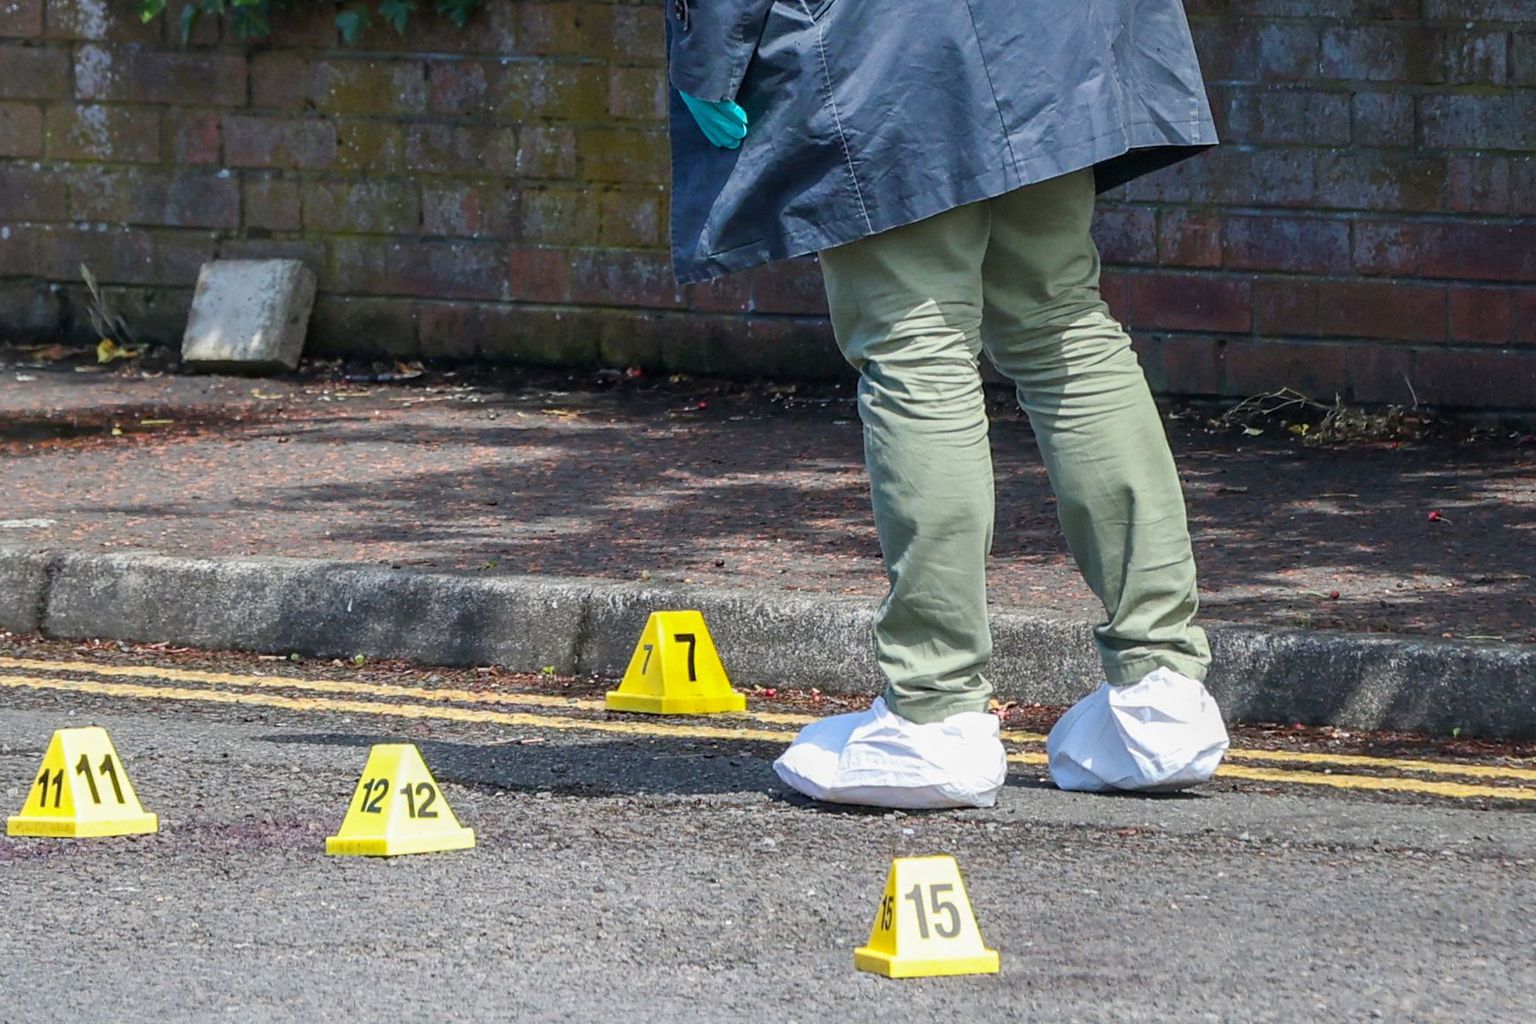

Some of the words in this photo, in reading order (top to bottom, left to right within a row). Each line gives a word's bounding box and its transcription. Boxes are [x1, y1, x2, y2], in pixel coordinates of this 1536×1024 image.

[642, 644, 653, 675] 7
[675, 633, 697, 682] 7
[37, 768, 63, 808] 11
[75, 753, 126, 805] 11
[361, 776, 390, 815] 12
[399, 781, 439, 819] 12
[880, 894, 894, 932] 15
[904, 883, 962, 940] 15
